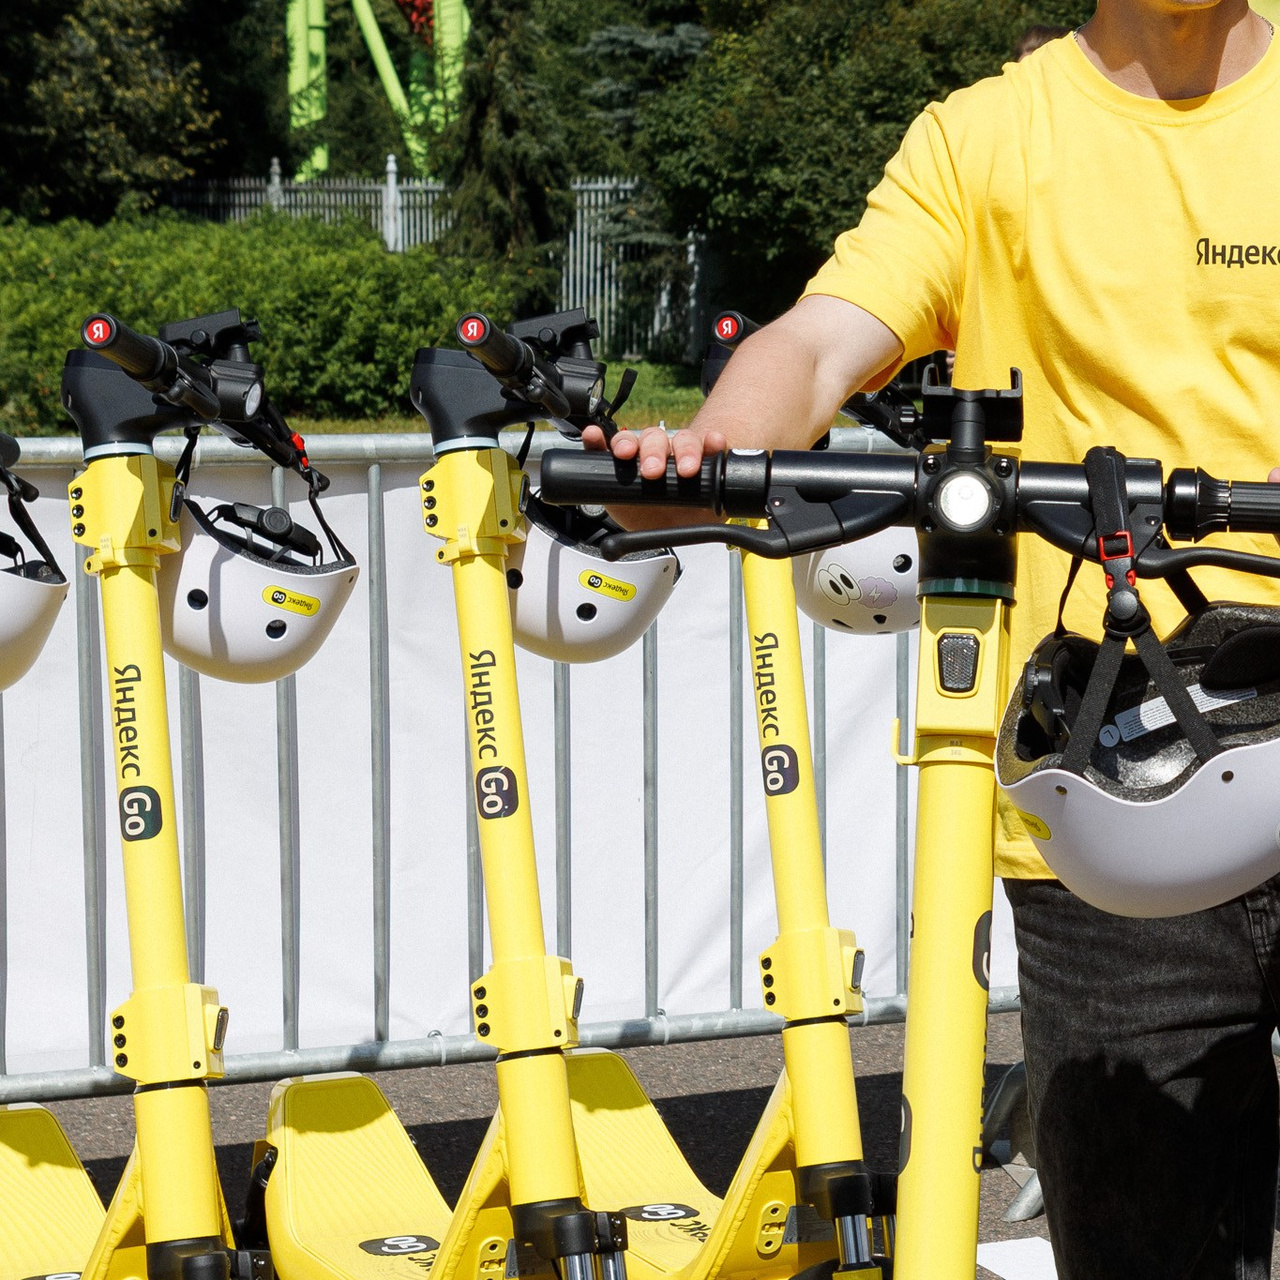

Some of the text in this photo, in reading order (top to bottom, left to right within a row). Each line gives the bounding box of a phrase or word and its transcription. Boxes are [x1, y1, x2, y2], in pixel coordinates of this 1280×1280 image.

[92, 322, 104, 339] Я
[467, 321, 478, 337] Я
[722, 319, 732, 335] Я
[589, 576, 602, 587] Go
[273, 591, 286, 603] Go
[754, 632, 792, 792] Яндекс Go
[469, 649, 511, 816] Яндекс Go
[113, 664, 154, 838] Яндекс Go
